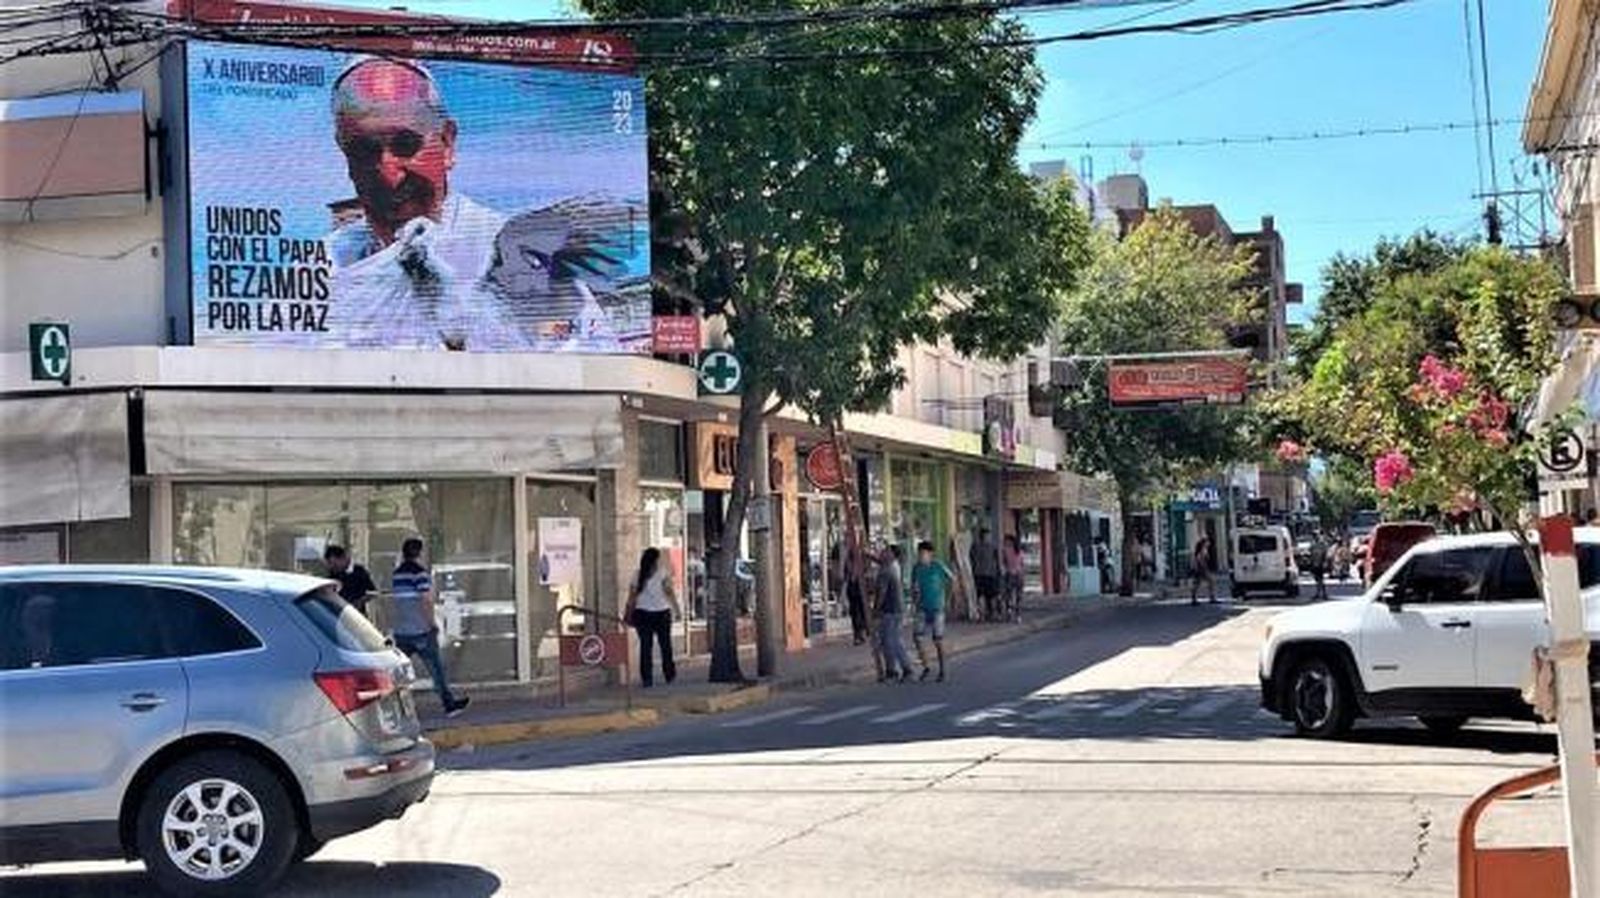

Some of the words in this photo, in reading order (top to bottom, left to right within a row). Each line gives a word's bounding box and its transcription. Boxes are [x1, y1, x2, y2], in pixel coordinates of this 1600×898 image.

[202, 58, 215, 80] X
[219, 59, 325, 87] ANIVERSARIO
[612, 90, 632, 111] 20
[612, 112, 633, 135] 23
[206, 205, 282, 236] UNIDOS
[207, 235, 246, 262] CON
[251, 237, 273, 263] EL
[278, 238, 333, 267] PAPA,
[207, 264, 330, 301] REZAMOS
[207, 301, 250, 331] POR
[256, 302, 283, 331] LA
[289, 303, 330, 332] PAZ
